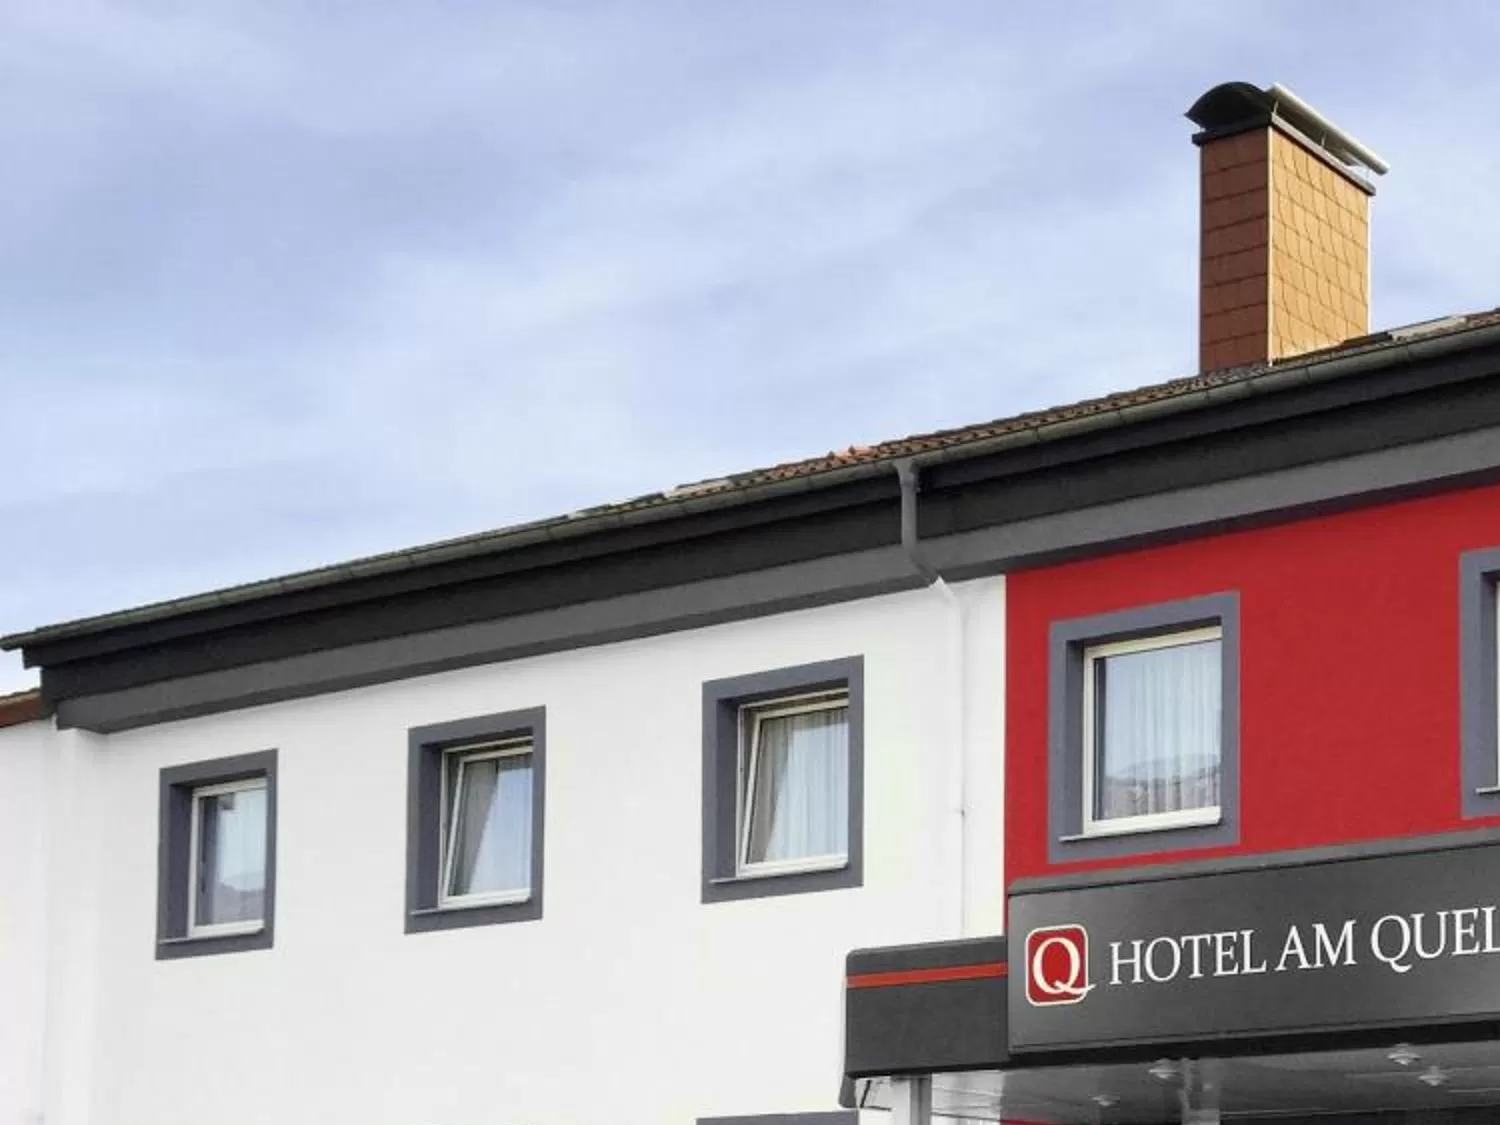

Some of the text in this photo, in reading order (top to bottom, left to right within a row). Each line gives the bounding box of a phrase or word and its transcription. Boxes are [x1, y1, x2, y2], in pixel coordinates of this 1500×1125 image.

[1033, 936, 1097, 995] Q
[1108, 929, 1267, 986] HOTEL
[1275, 919, 1357, 973] AM
